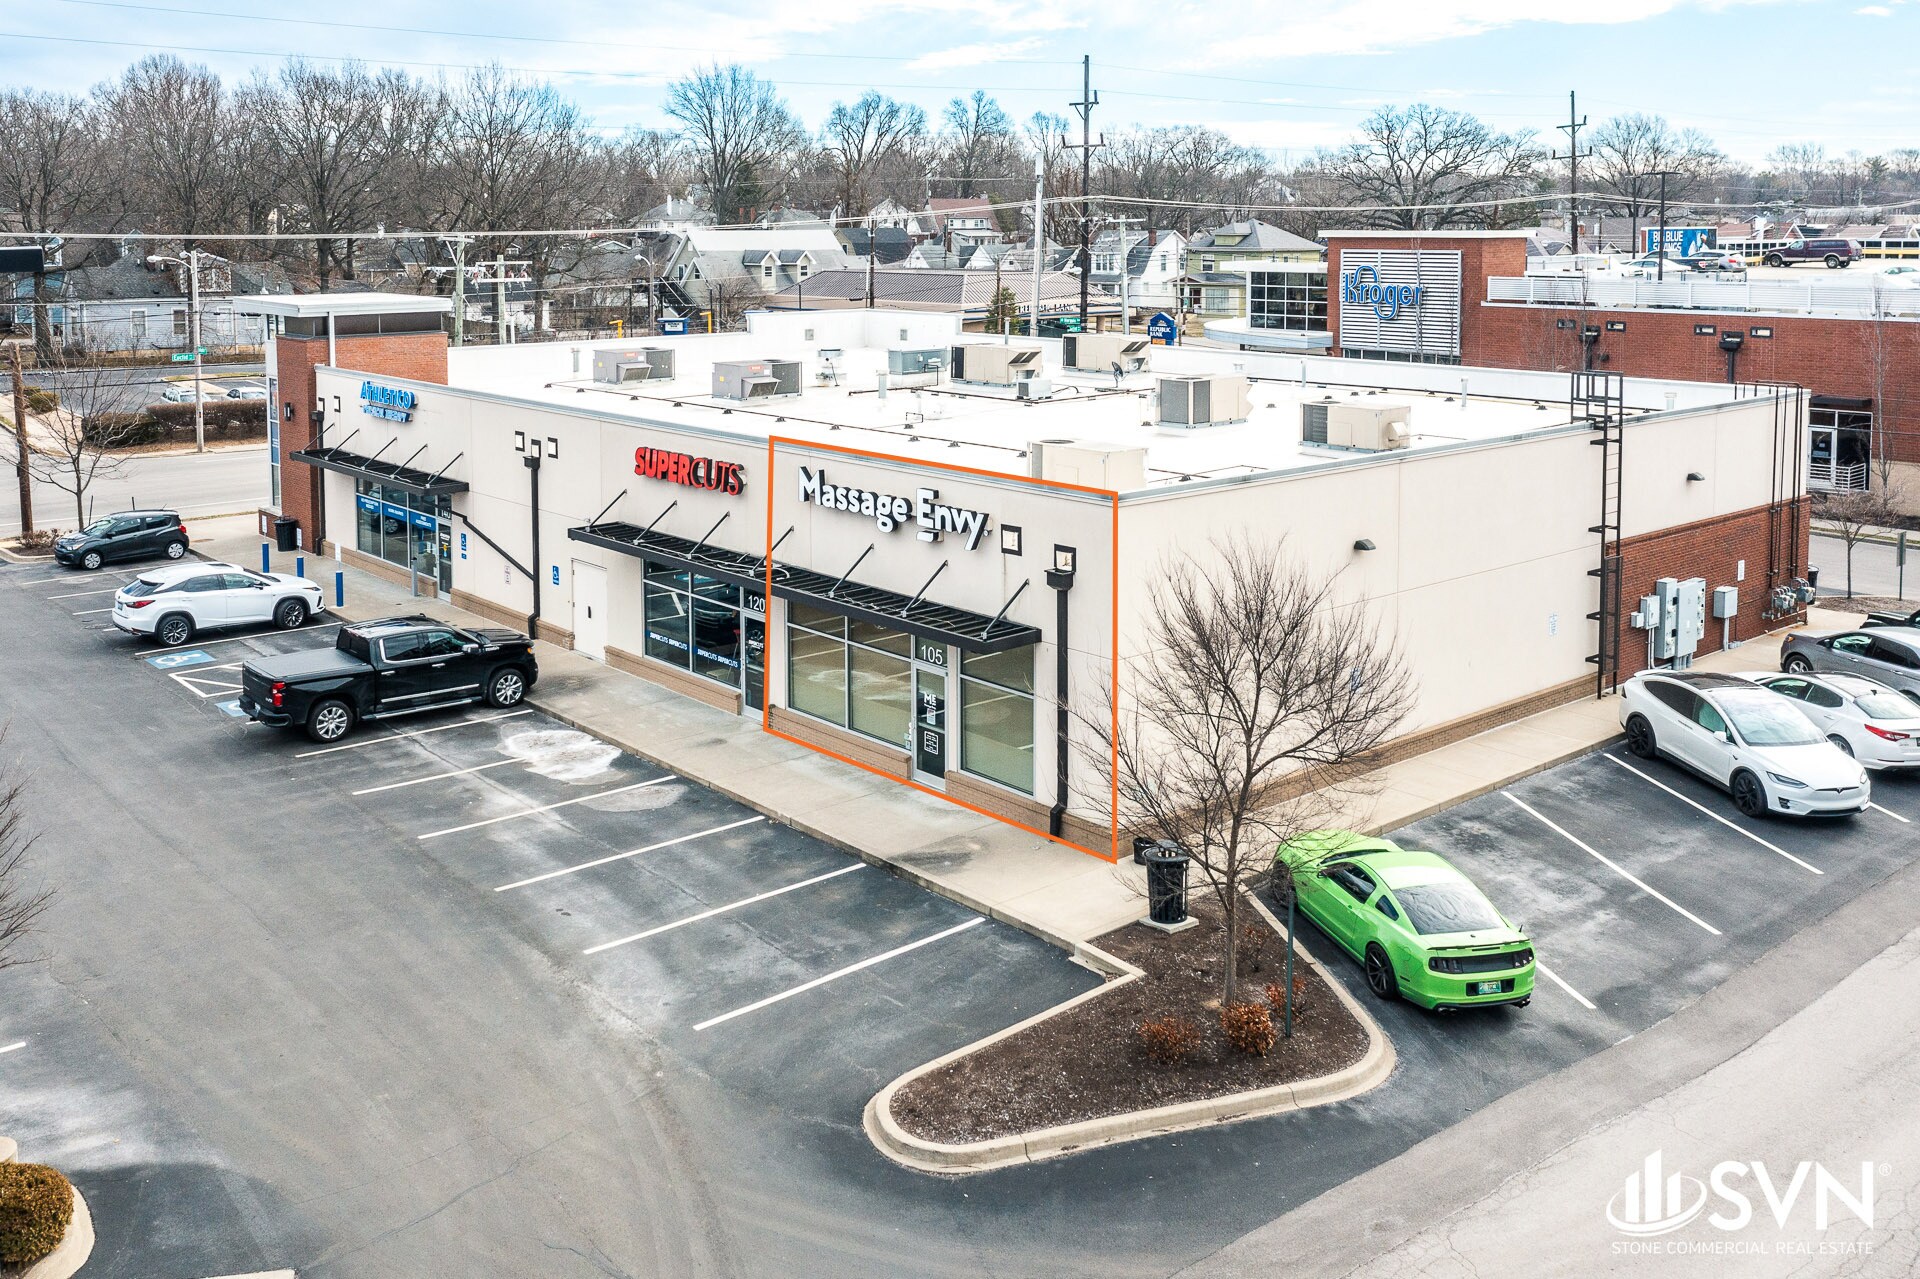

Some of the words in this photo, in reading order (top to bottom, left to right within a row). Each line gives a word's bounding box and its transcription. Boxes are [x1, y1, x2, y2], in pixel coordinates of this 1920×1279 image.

[1653, 231, 1664, 242] BI
[1666, 231, 1683, 241] BLUE
[1345, 265, 1422, 319] Kroger
[360, 381, 414, 409] ATHLETICO
[634, 446, 744, 496] SUPERCUTS
[798, 466, 910, 533] Massage
[916, 488, 989, 551] Envy
[748, 595, 765, 612] 120
[921, 645, 943, 665] 105
[923, 692, 937, 706] ME
